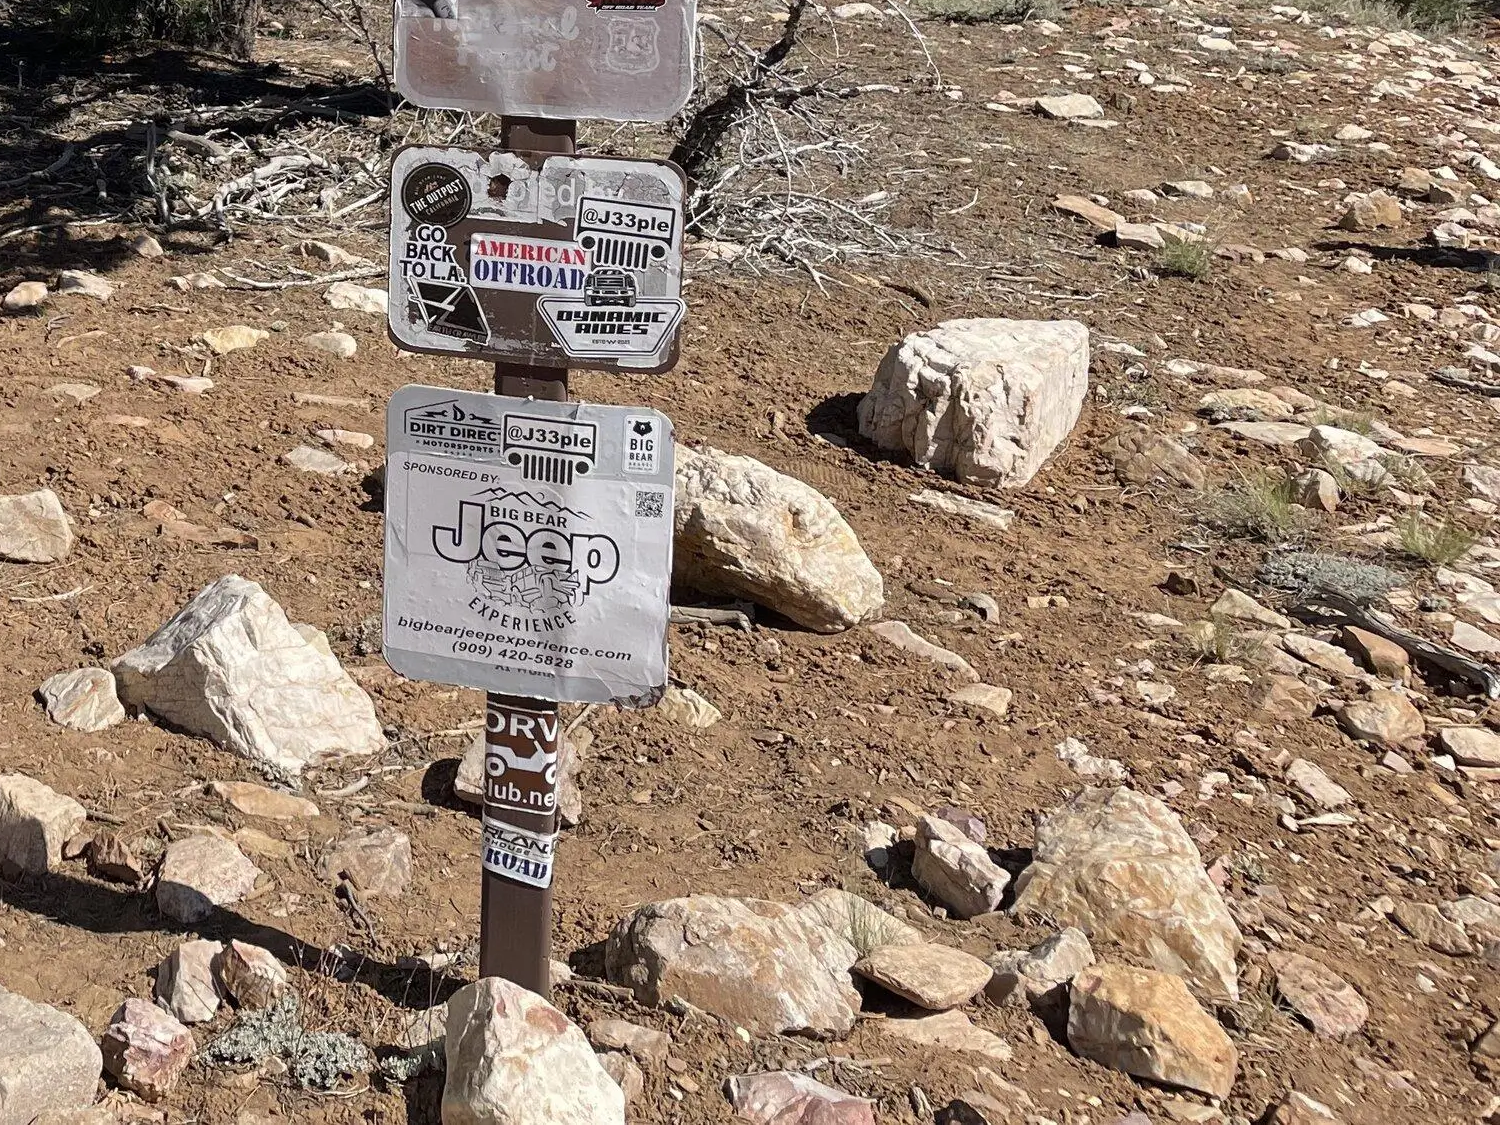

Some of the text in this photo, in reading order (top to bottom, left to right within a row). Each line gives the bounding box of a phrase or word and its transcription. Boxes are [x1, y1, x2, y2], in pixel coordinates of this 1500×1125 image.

[409, 197, 428, 214] THE
[427, 179, 464, 204] OUTPOST
[583, 208, 670, 232] @J33ple
[417, 226, 445, 243] GO
[406, 243, 454, 263] BACK
[475, 240, 586, 265] AMERICAN
[400, 260, 466, 283] TO L.A.
[474, 259, 585, 291] OFFROAD
[557, 310, 667, 323] DYNAMIC
[575, 323, 648, 335] RIDES
[410, 422, 445, 436] DIRT
[508, 425, 592, 449] @J33ple
[423, 438, 494, 454] MOTORSPORTS
[629, 452, 653, 462] BEAR
[630, 438, 654, 452] BIG
[403, 461, 500, 485] SPONSORED BY:
[490, 505, 567, 529] BIG BEAR
[432, 500, 620, 596] Jeep
[468, 596, 576, 633] EXPERIENCE
[398, 616, 632, 661] bigbearjeepexperience.com
[452, 641, 574, 669] (909) 420-5828
[486, 709, 557, 743] ORV
[485, 847, 548, 880] ROAD
